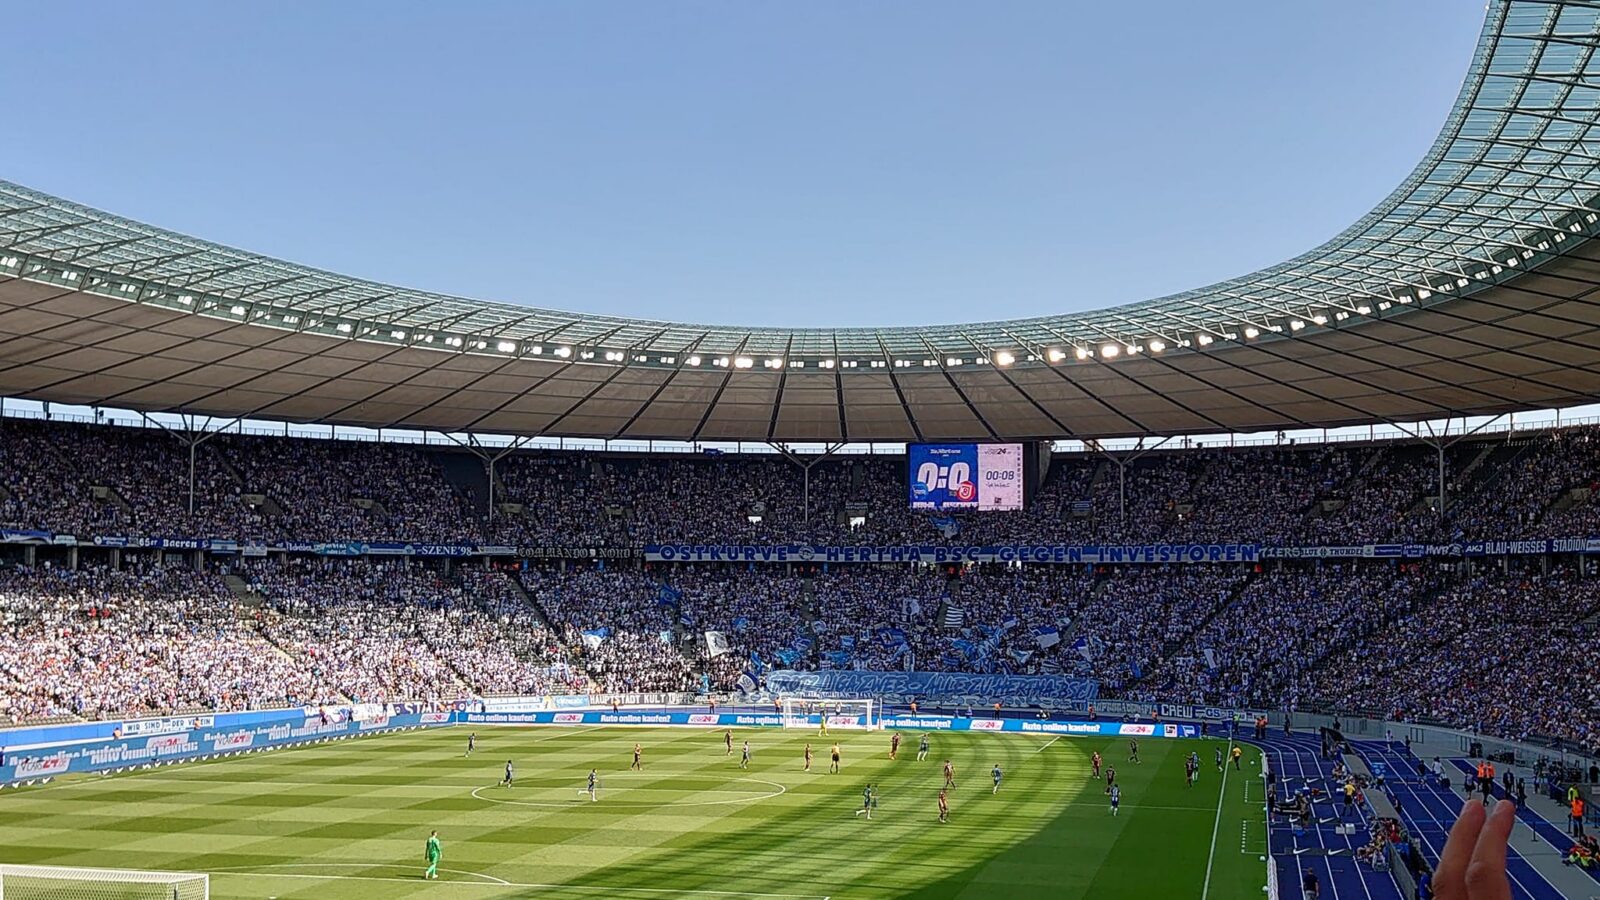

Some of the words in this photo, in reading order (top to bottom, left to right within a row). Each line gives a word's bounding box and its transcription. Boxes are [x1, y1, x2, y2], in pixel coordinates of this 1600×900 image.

[986, 470, 1015, 480] 00:08
[1485, 540, 1547, 554] BLAU-WEISSES
[518, 547, 588, 558] COMMANDO
[598, 548, 631, 558] NORD
[659, 545, 788, 561] OSTKURVE
[826, 546, 921, 562] HERTHA
[934, 546, 981, 562] BSC
[999, 546, 1083, 562] GEGEN
[1098, 545, 1256, 562] INVESTOREN
[643, 694, 666, 704] KULT
[1161, 704, 1193, 718] CREW
[468, 714, 484, 722] Auto
[485, 714, 507, 722] online
[508, 714, 537, 723] kaufen?
[600, 714, 618, 723] Auto
[619, 714, 641, 723] online
[641, 714, 671, 724] kaufen?
[736, 716, 754, 724] Auto
[896, 719, 920, 728] online
[920, 720, 952, 729] kaufen?
[1022, 723, 1042, 731] Auto
[1042, 723, 1068, 732] online
[1068, 723, 1101, 733] kaufen?
